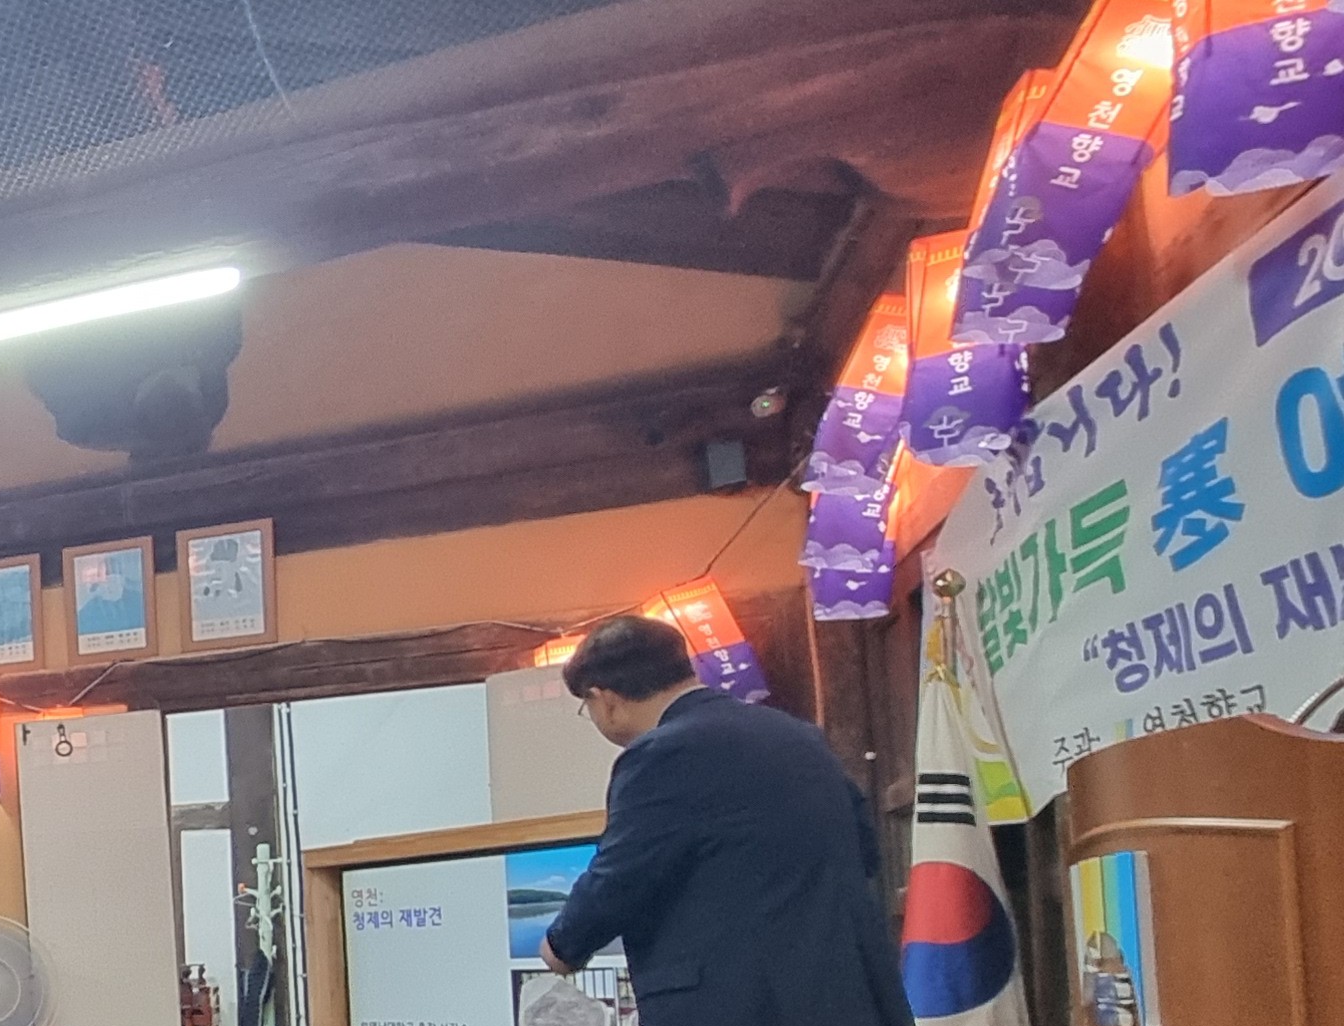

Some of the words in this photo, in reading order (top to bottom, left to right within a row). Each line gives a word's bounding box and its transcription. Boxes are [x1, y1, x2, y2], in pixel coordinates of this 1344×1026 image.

[1050, 67, 1143, 189] 영천향교
[842, 353, 891, 429] 영천향교
[351, 887, 384, 909] 영천:
[353, 911, 393, 931] 청제의
[399, 906, 443, 928] 재발견
